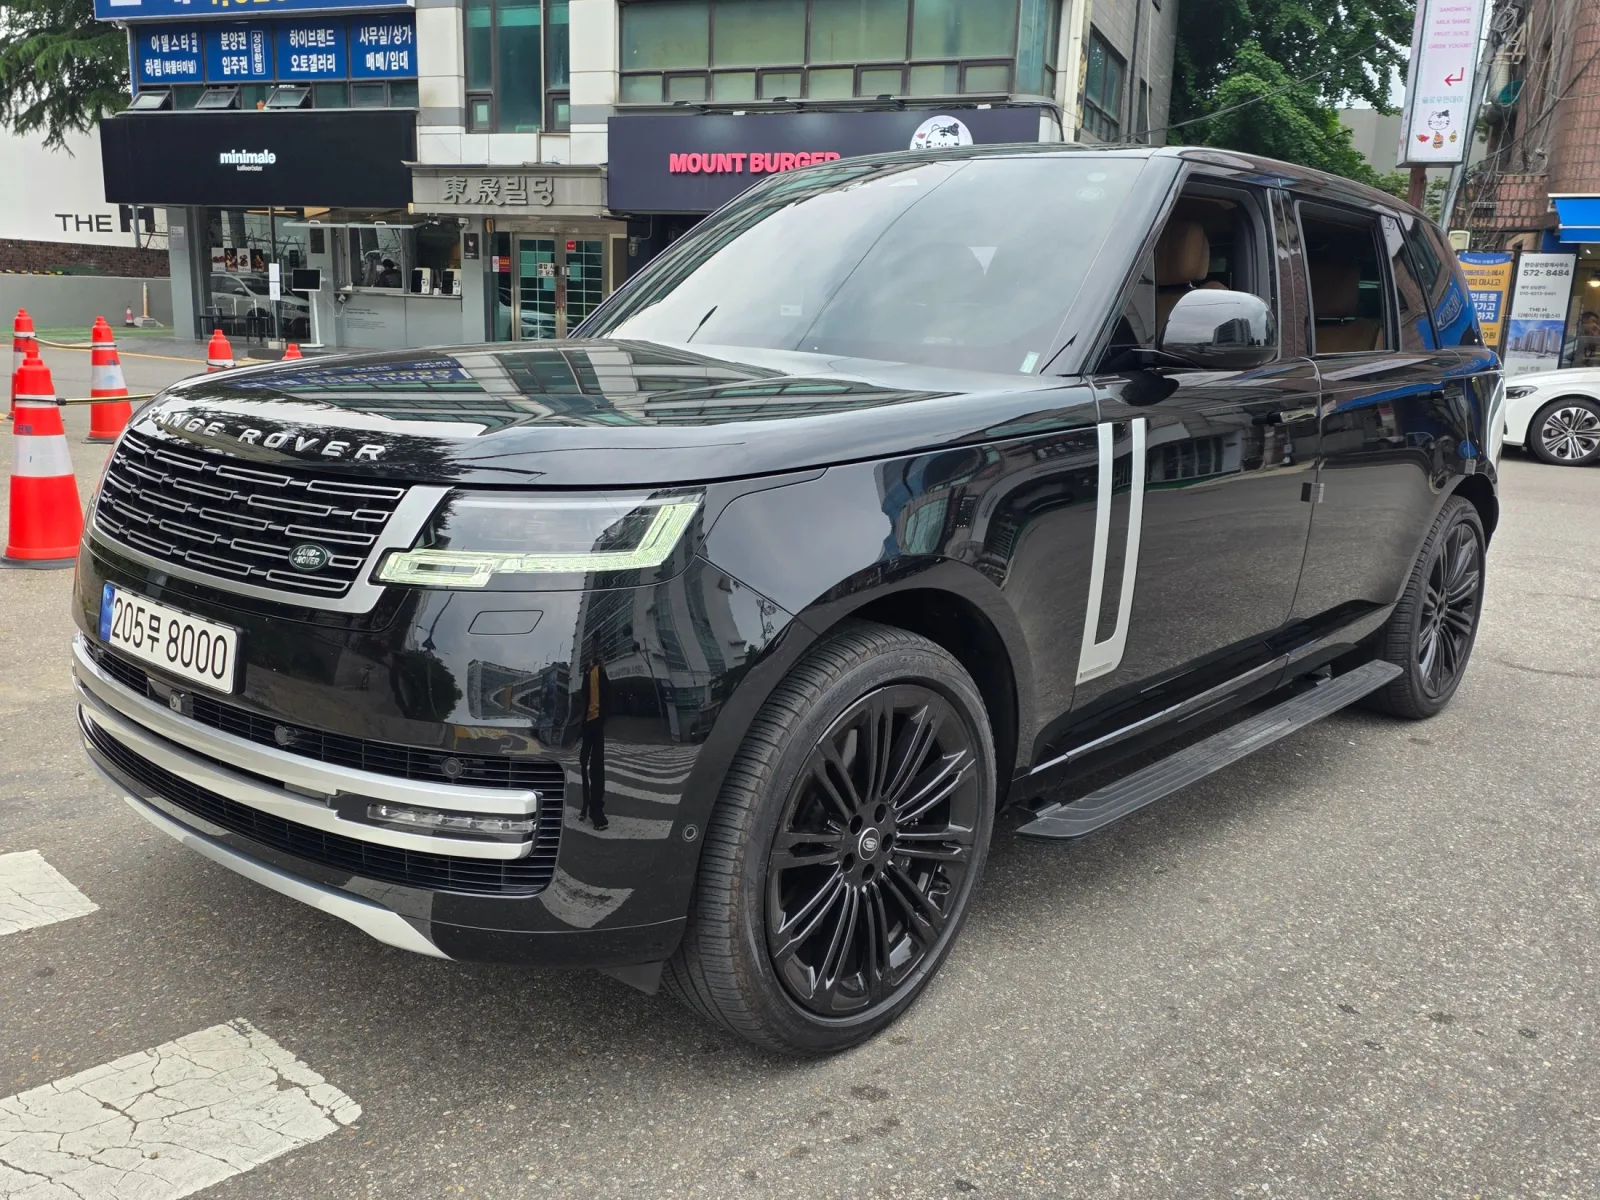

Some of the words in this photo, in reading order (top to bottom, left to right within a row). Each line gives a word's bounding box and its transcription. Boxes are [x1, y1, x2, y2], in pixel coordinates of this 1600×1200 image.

[151, 34, 189, 53] 아델스타
[220, 31, 247, 50] 분양권
[289, 28, 335, 48] 하이브랜드
[359, 24, 412, 46] 사무실/상가
[222, 56, 248, 75] 입주권
[290, 53, 336, 73] 오토갤러리
[365, 50, 409, 71] 매매/임대
[220, 149, 276, 164] minimale
[669, 152, 747, 174] MOUNT
[55, 213, 113, 232] THE
[1546, 269, 1570, 277] 8484
[148, 406, 226, 437] RANGE
[237, 427, 386, 461] ROVER
[111, 597, 161, 653] 205무
[166, 619, 228, 679] 8000
